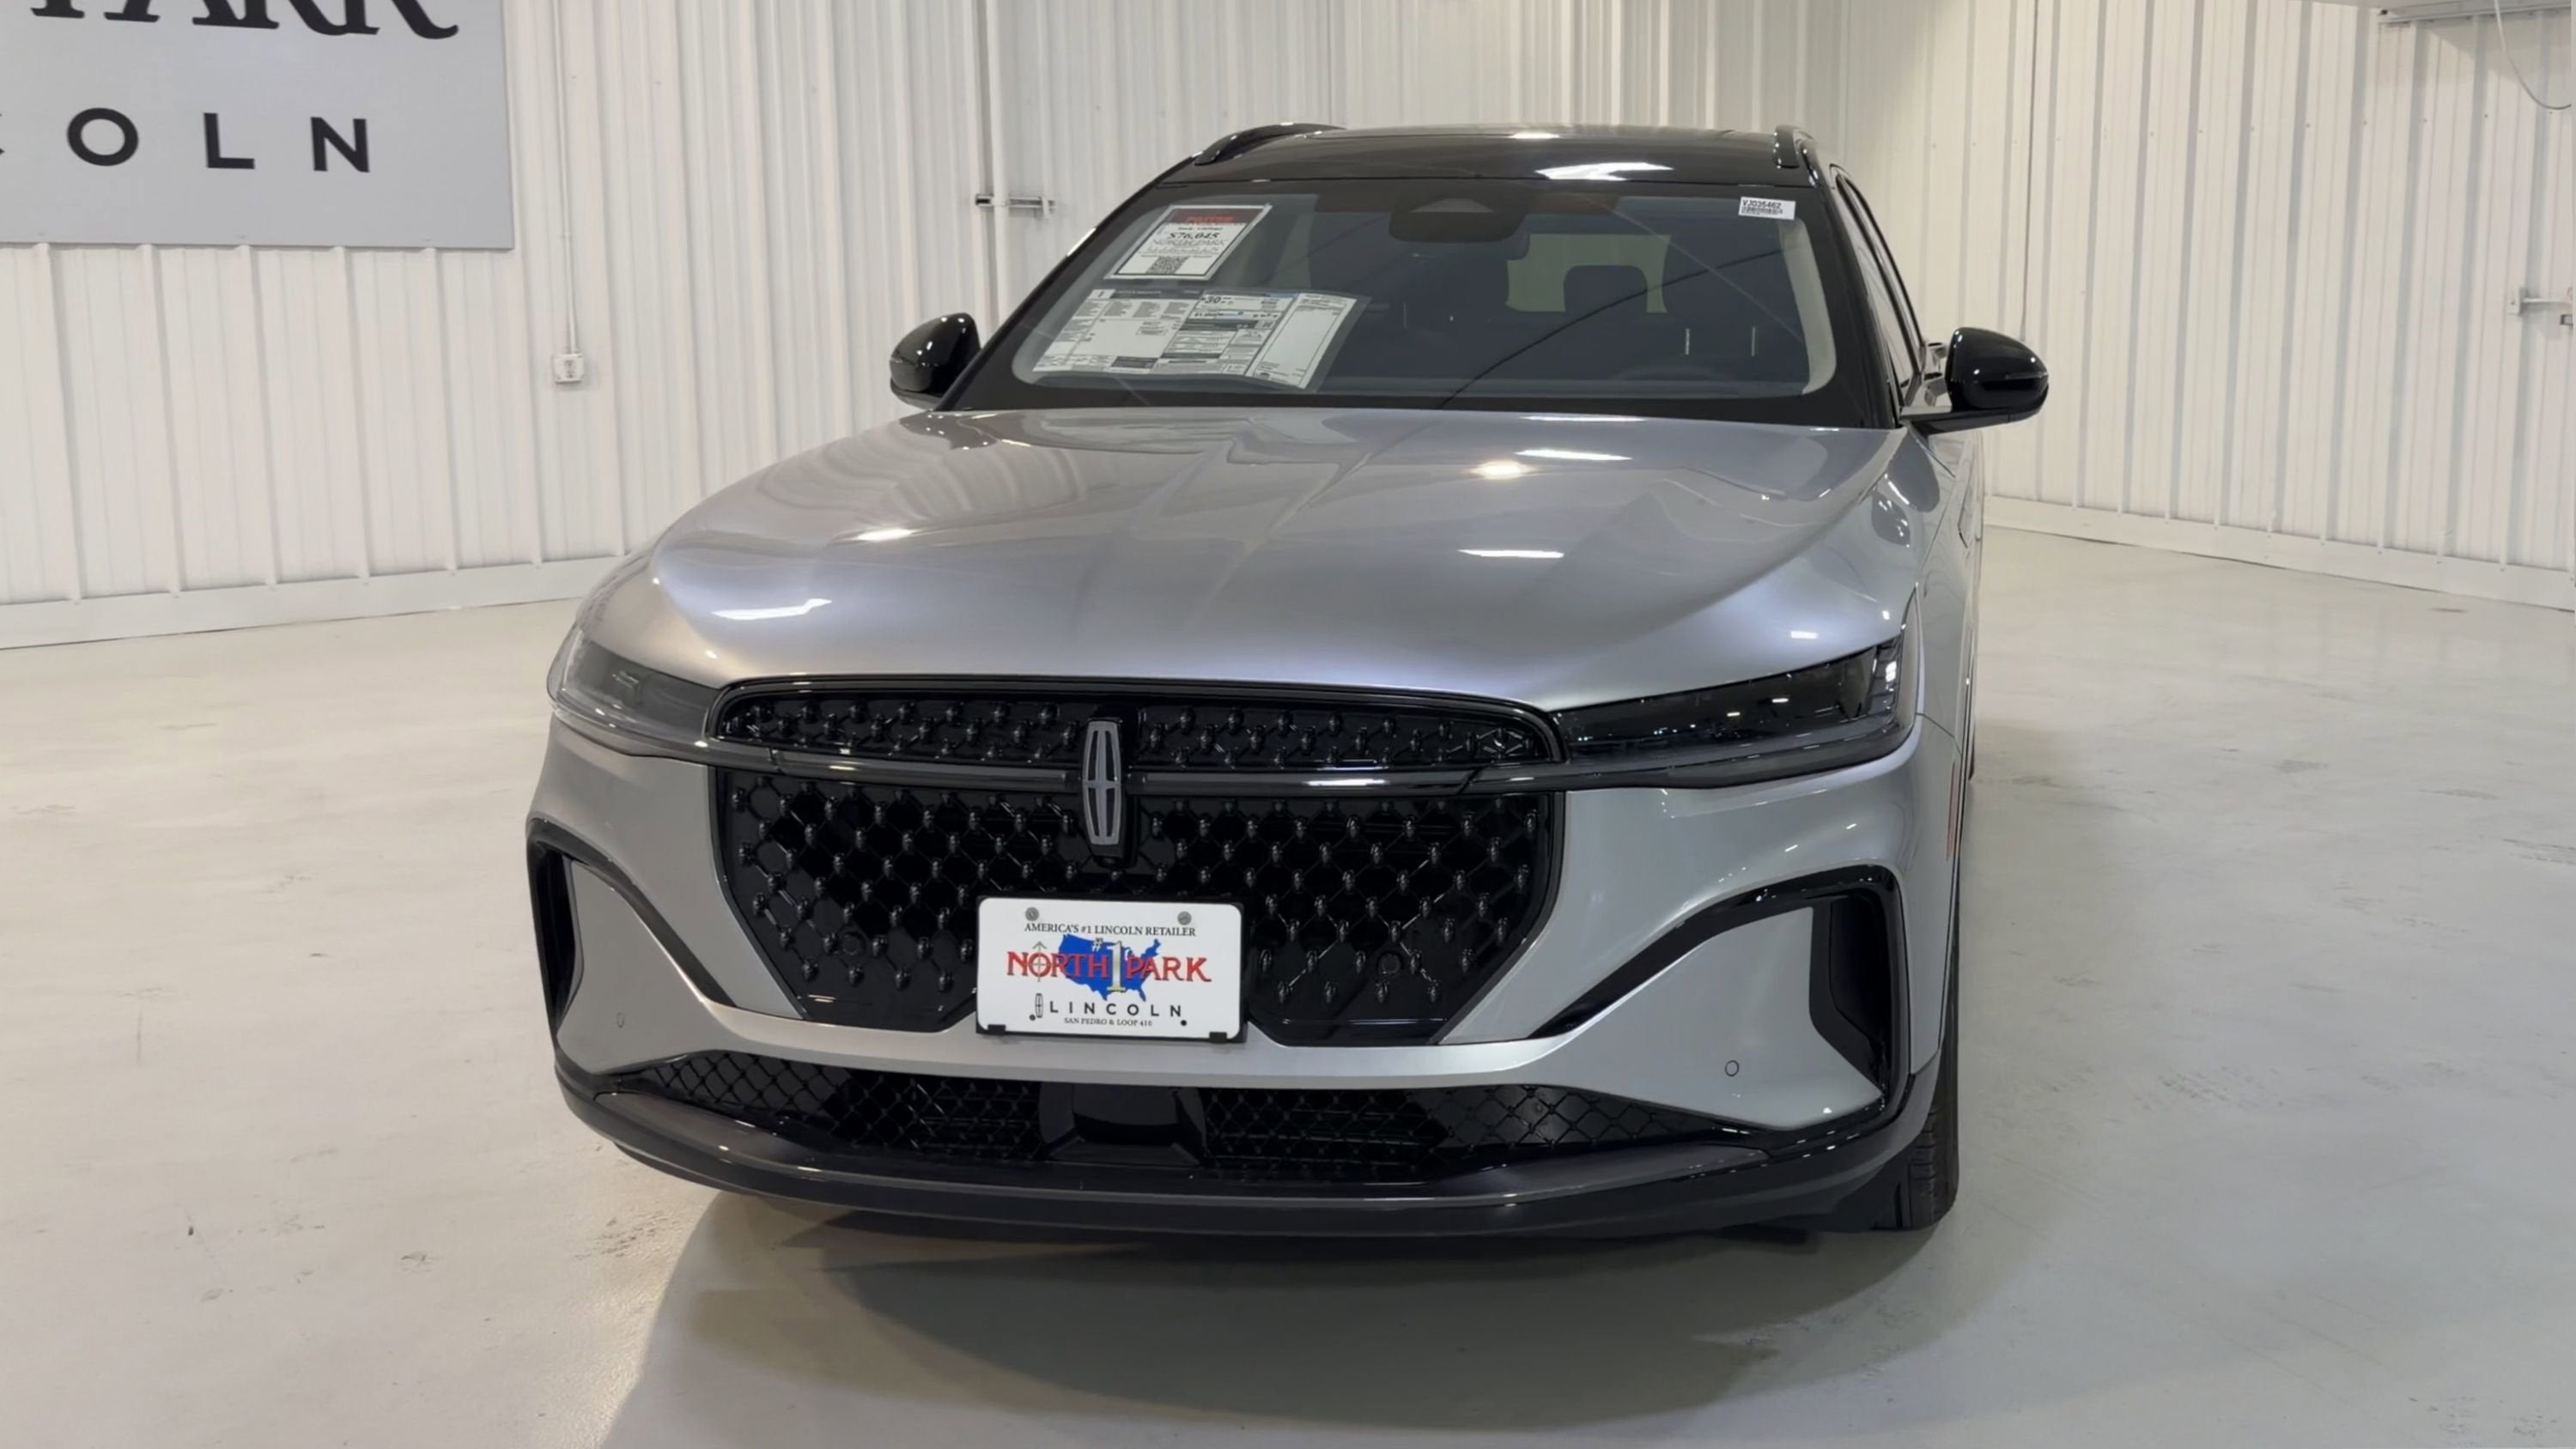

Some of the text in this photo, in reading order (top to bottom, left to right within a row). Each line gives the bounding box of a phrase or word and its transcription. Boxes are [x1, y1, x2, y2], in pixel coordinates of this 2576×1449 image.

[0, 107, 370, 173] OLN
[1024, 923, 1196, 937] AMERICA'S #1 LINCOLN RETAILER
[1006, 950, 1212, 982] NORTH PARK
[1049, 1000, 1182, 1017] LINCOLN
